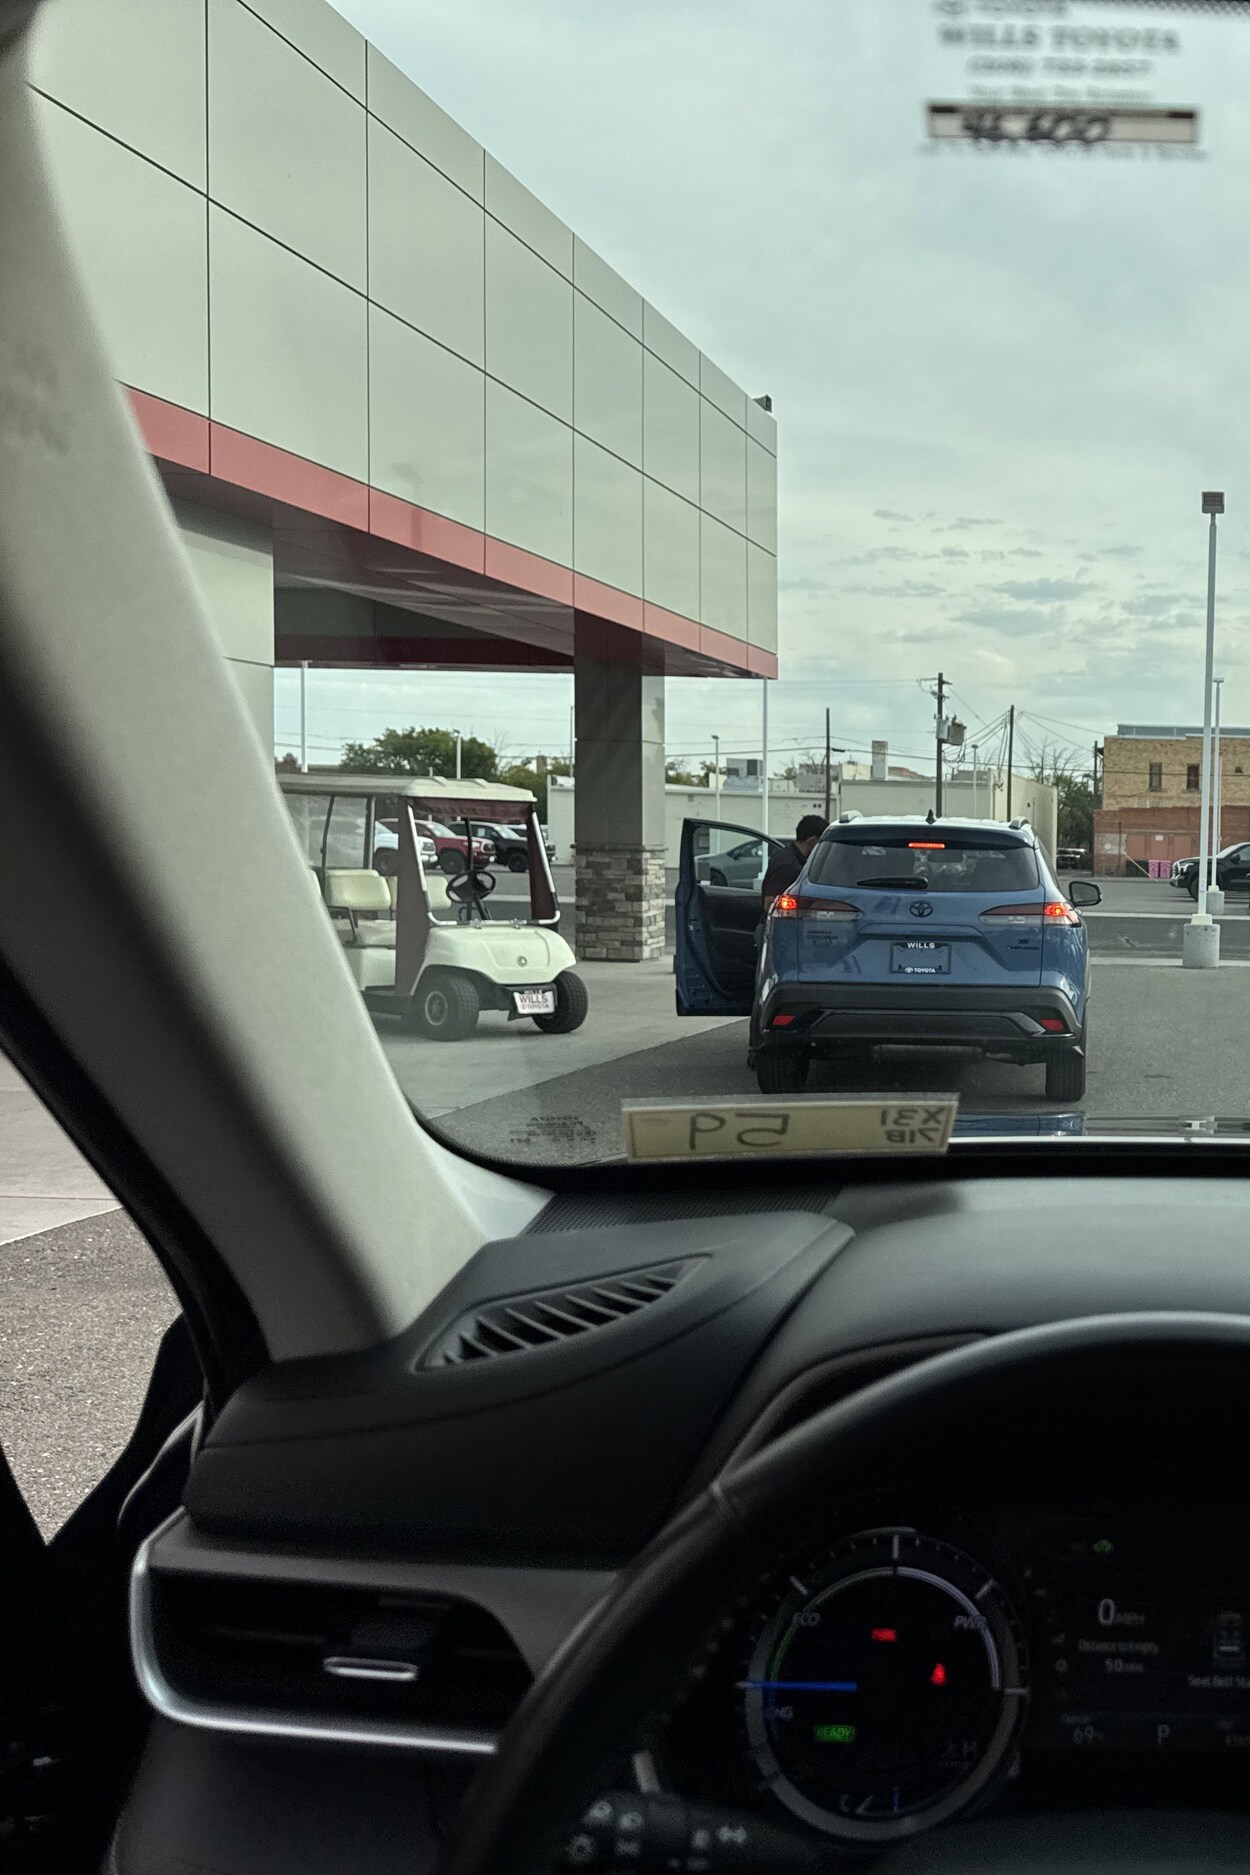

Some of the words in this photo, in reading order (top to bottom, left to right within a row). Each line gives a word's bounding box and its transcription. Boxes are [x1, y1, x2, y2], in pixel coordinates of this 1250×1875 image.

[519, 994, 548, 1004] WILLS
[792, 1612, 821, 1626] ECO
[953, 1614, 987, 1630] PWR
[816, 1727, 855, 1740] READY
